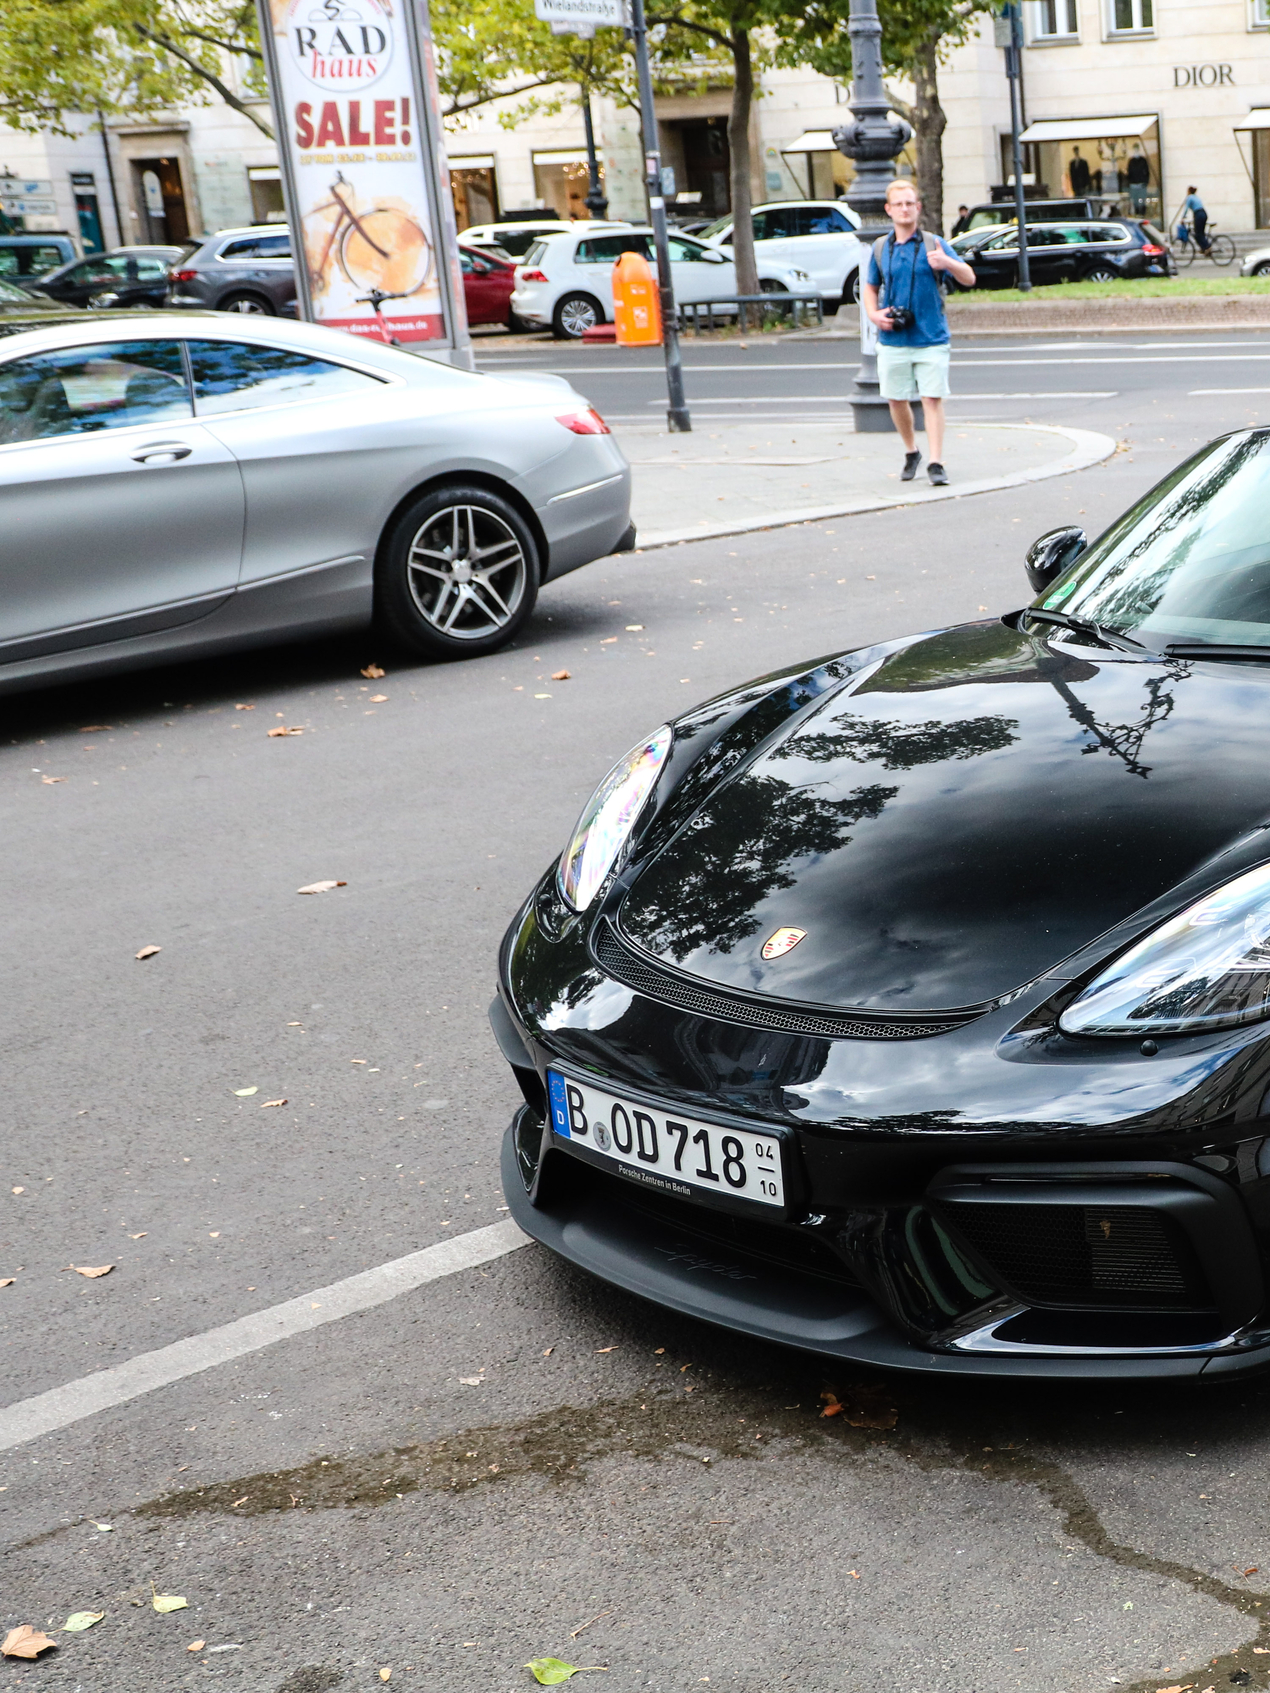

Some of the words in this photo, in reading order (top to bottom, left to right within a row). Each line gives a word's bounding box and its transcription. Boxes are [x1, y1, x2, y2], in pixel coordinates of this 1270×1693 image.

[294, 26, 386, 57] RAD
[311, 49, 378, 79] haus
[1173, 63, 1237, 87] DIOR
[295, 97, 412, 149] SALE!
[557, 1110, 565, 1125] D
[566, 1083, 588, 1136] B
[755, 1143, 774, 1161] 04
[618, 1164, 641, 1180] Porsche
[641, 1173, 665, 1188] Zentren
[665, 1180, 672, 1190] in
[672, 1182, 691, 1196] Berlin
[760, 1180, 777, 1197] 10
